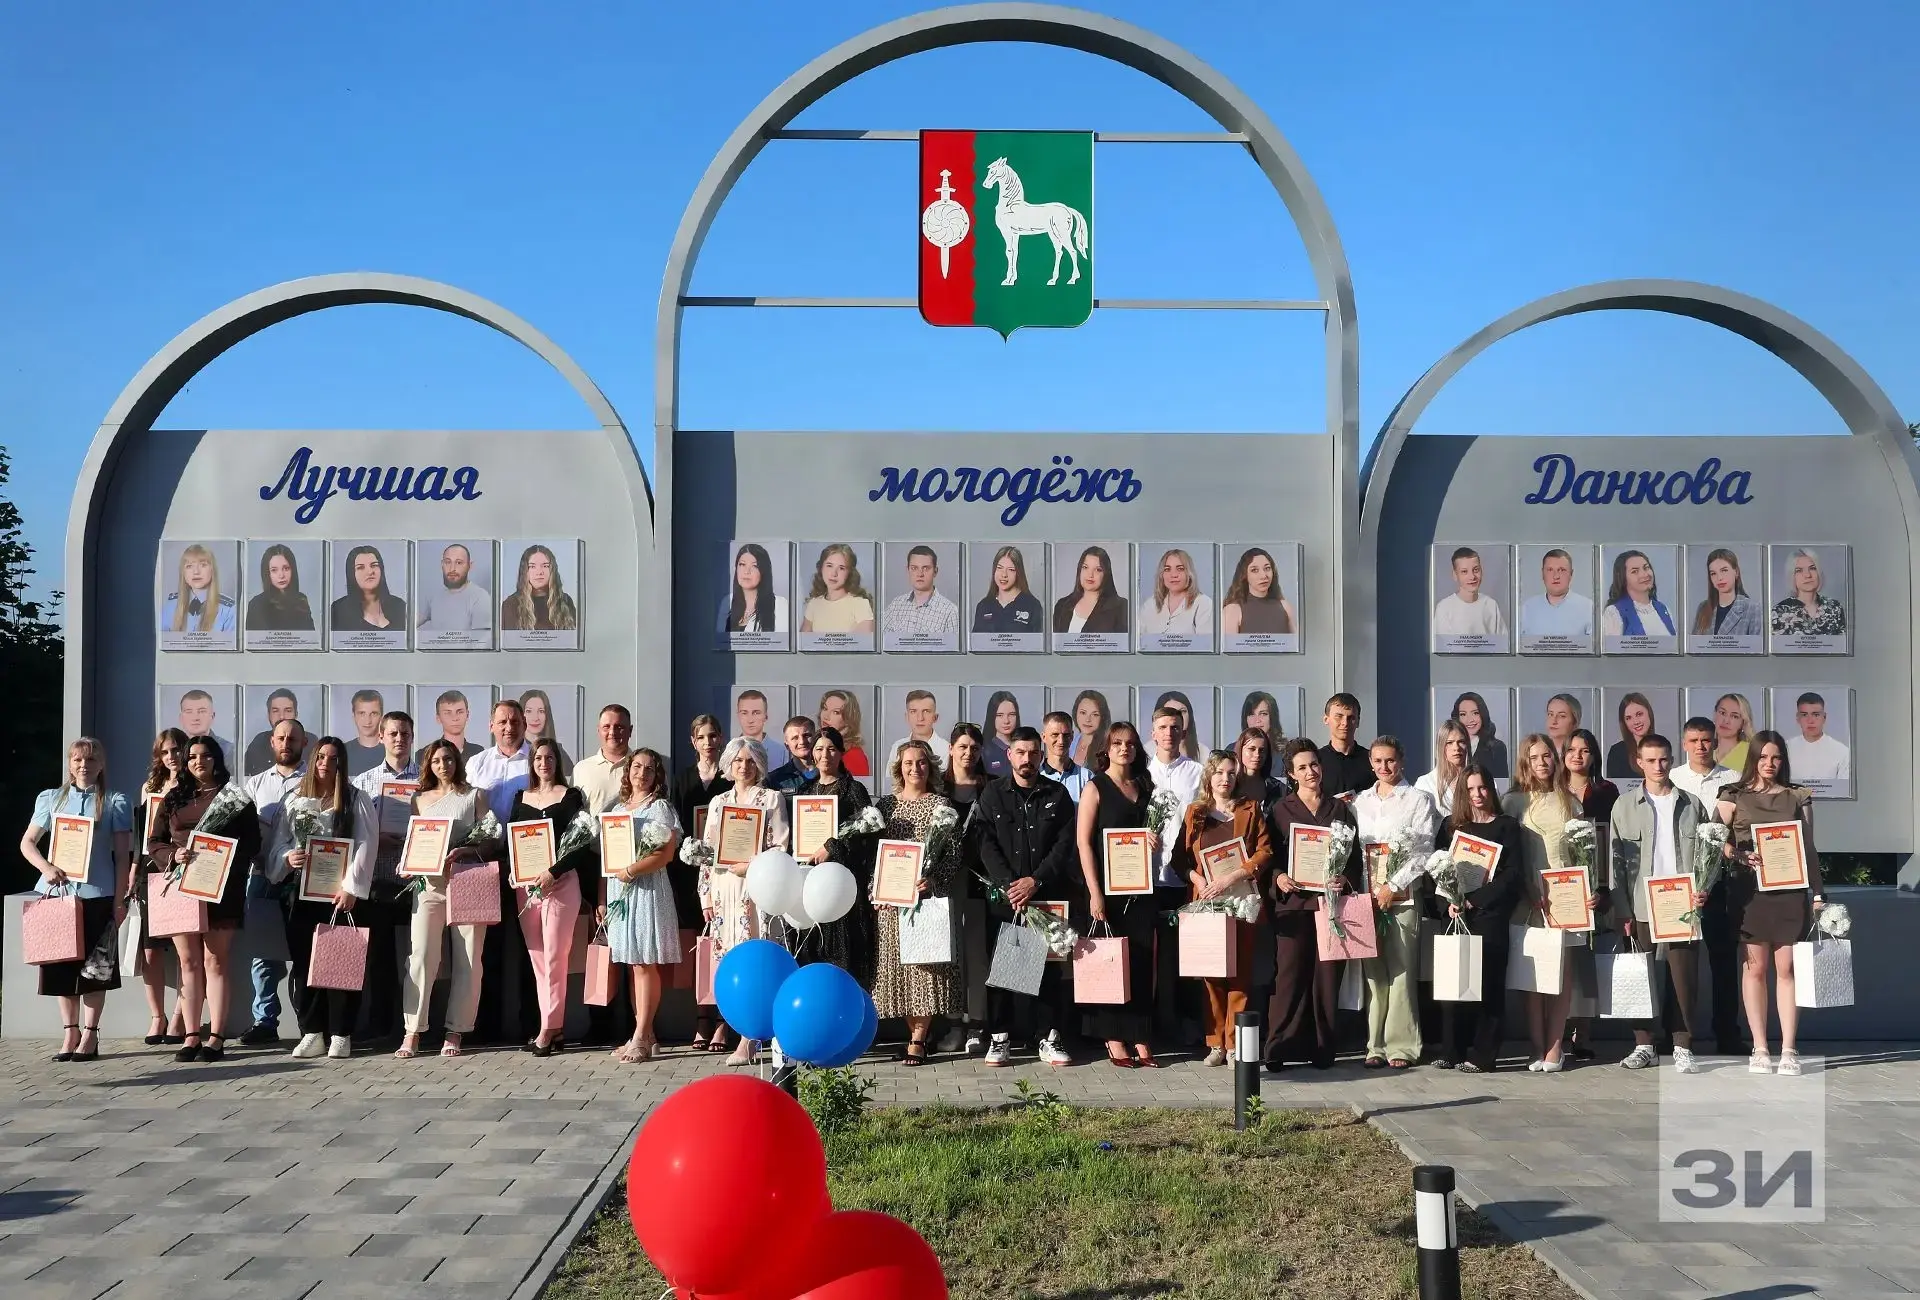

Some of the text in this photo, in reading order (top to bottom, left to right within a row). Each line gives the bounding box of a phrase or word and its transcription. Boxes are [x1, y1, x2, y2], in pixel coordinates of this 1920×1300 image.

[259, 446, 483, 525] Лучшая
[868, 455, 1143, 527] молодёжь
[1524, 453, 1754, 505] Данкова
